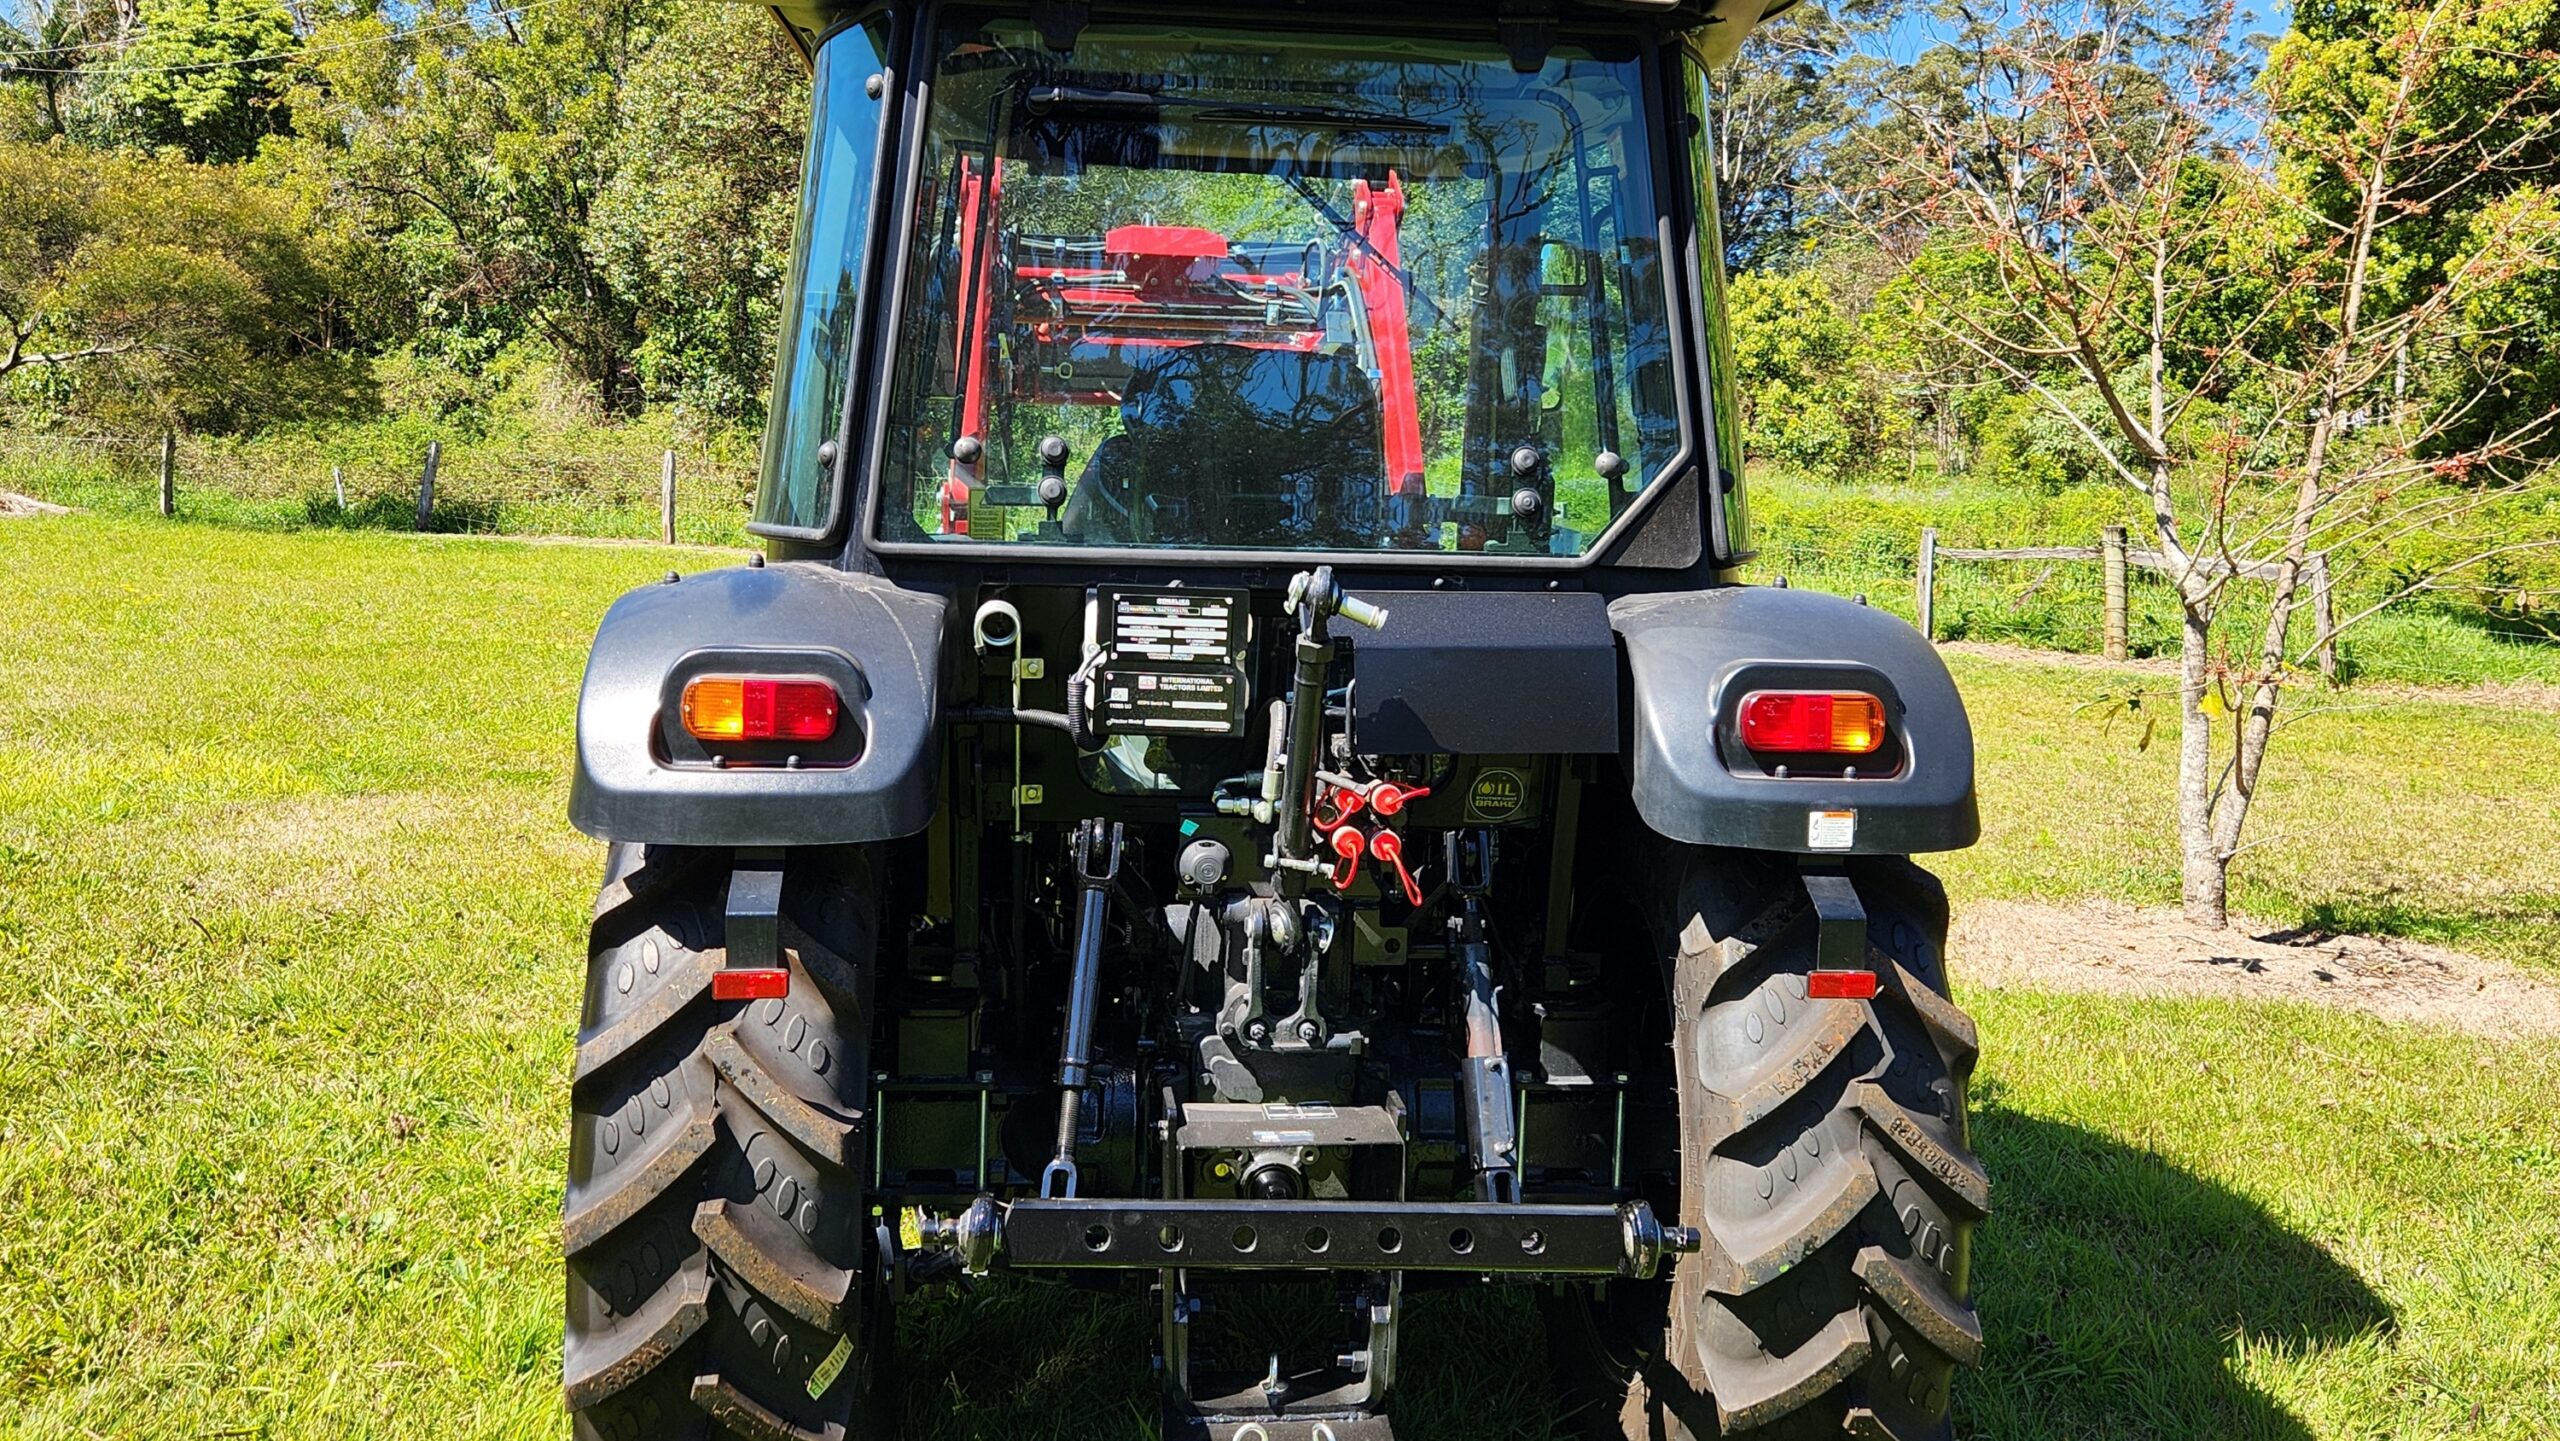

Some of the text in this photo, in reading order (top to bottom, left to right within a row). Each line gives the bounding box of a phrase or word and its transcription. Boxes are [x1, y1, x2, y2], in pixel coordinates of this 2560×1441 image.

[1161, 677, 1214, 685] INTERNATIONAL
[1159, 684, 1196, 692] TRACTORS
[1477, 782, 1516, 796] OIL
